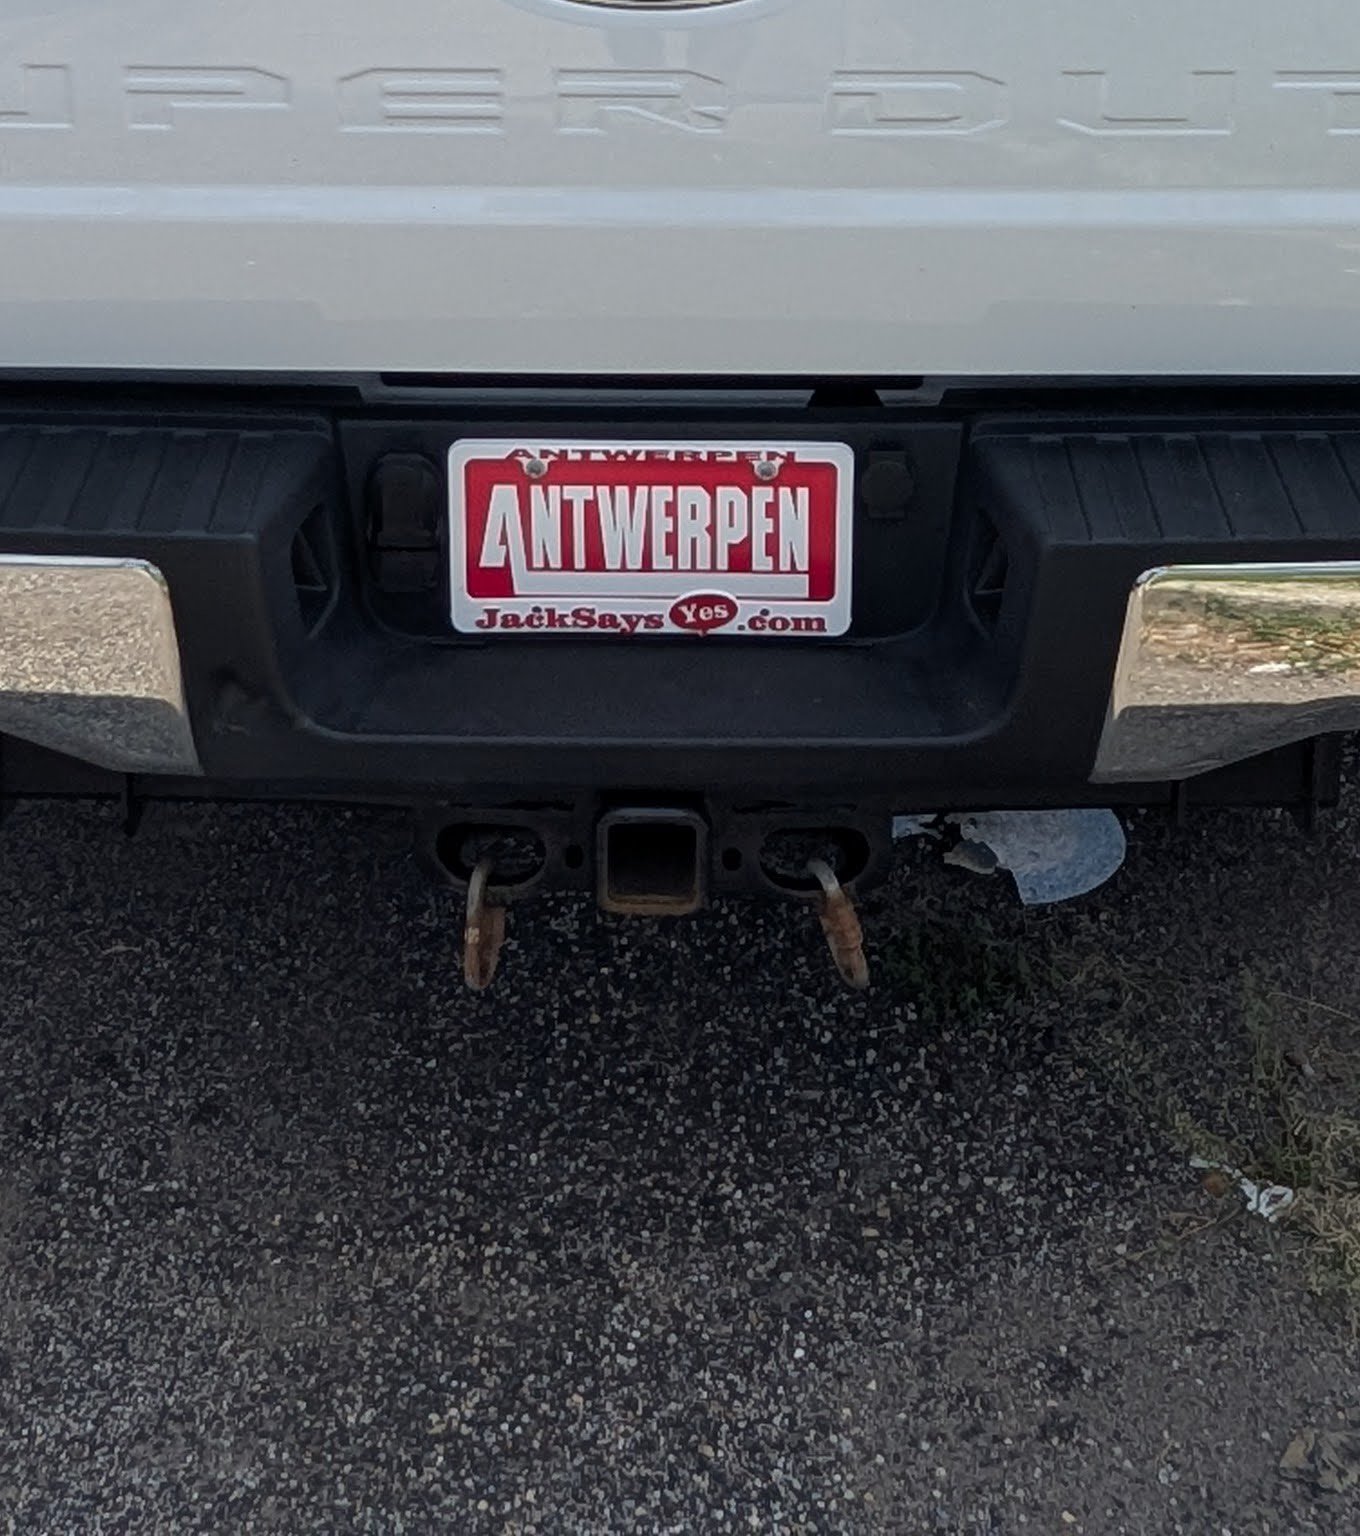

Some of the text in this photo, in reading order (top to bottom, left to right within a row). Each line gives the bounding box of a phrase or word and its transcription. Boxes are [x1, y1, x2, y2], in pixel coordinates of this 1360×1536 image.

[478, 484, 810, 574] ANTWERPEN
[475, 606, 664, 635] JackSays
[677, 602, 729, 625] Yes
